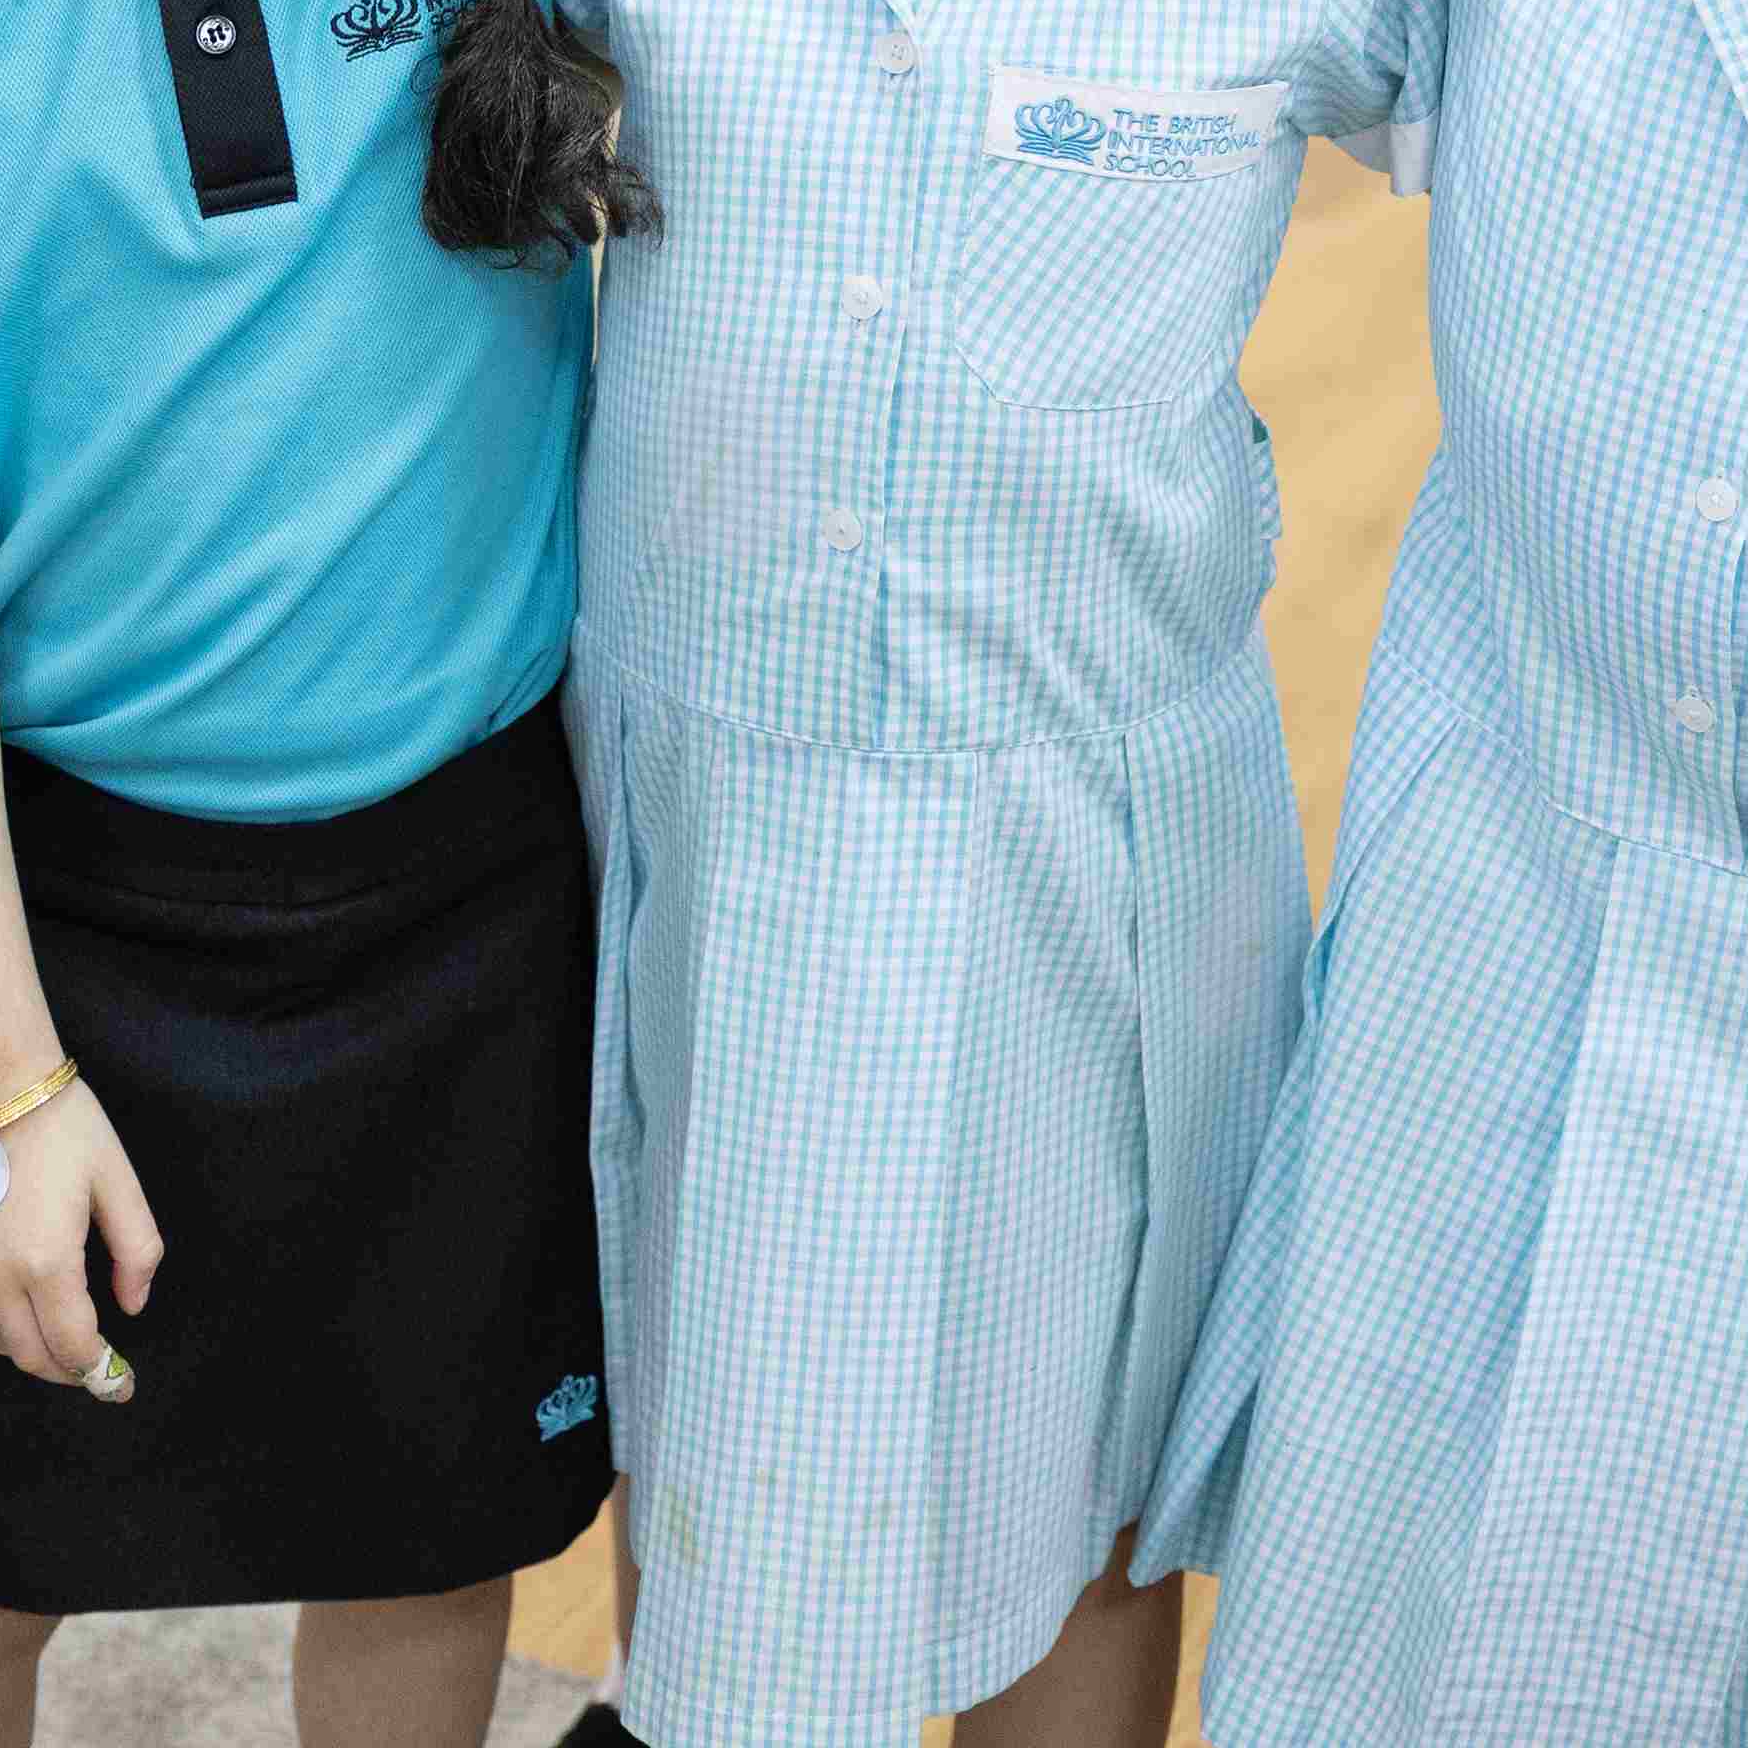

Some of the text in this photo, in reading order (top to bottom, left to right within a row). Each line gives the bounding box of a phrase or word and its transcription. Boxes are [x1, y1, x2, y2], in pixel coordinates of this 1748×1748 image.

[1113, 107, 1238, 134] THE BRITISH
[1107, 130, 1260, 157] INTERNATIONAL
[1103, 154, 1197, 178] SCHOOL
